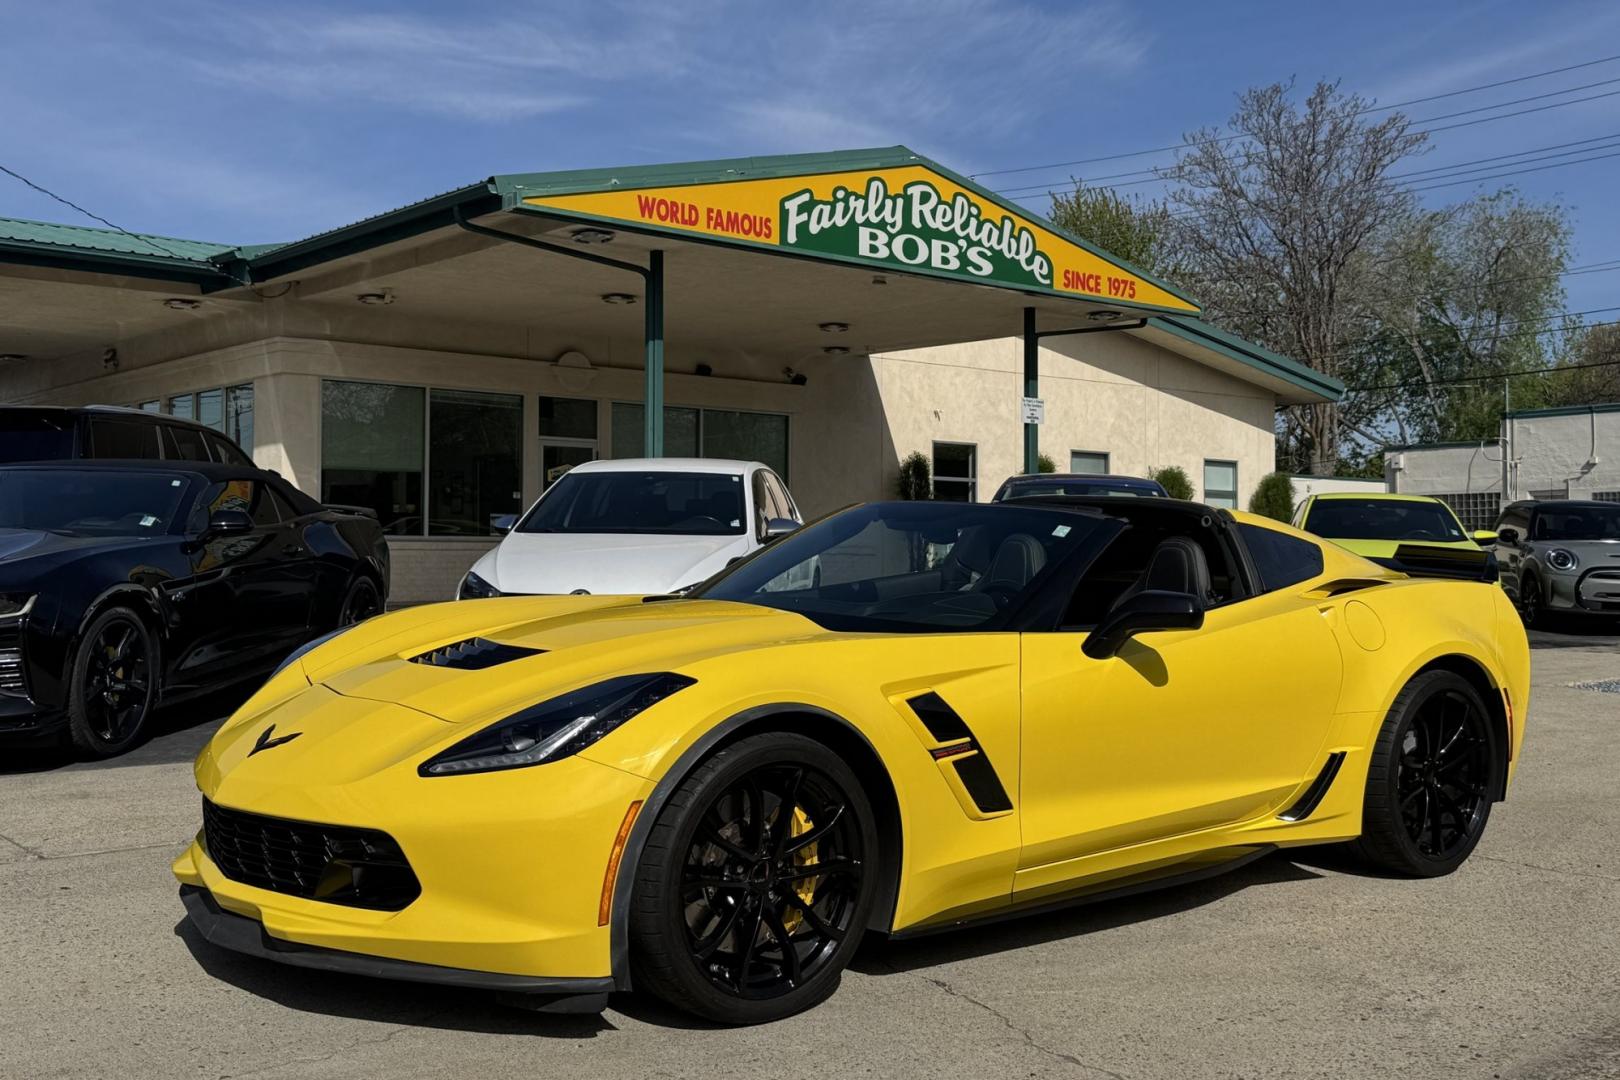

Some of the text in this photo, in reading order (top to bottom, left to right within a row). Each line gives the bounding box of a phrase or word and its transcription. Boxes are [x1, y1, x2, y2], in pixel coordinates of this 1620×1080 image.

[637, 194, 773, 240] WORLD FAMOUS
[784, 180, 1051, 284] Fairly Reliable
[858, 226, 994, 277] BOB'S
[1063, 268, 1136, 299] SINCE 1975
